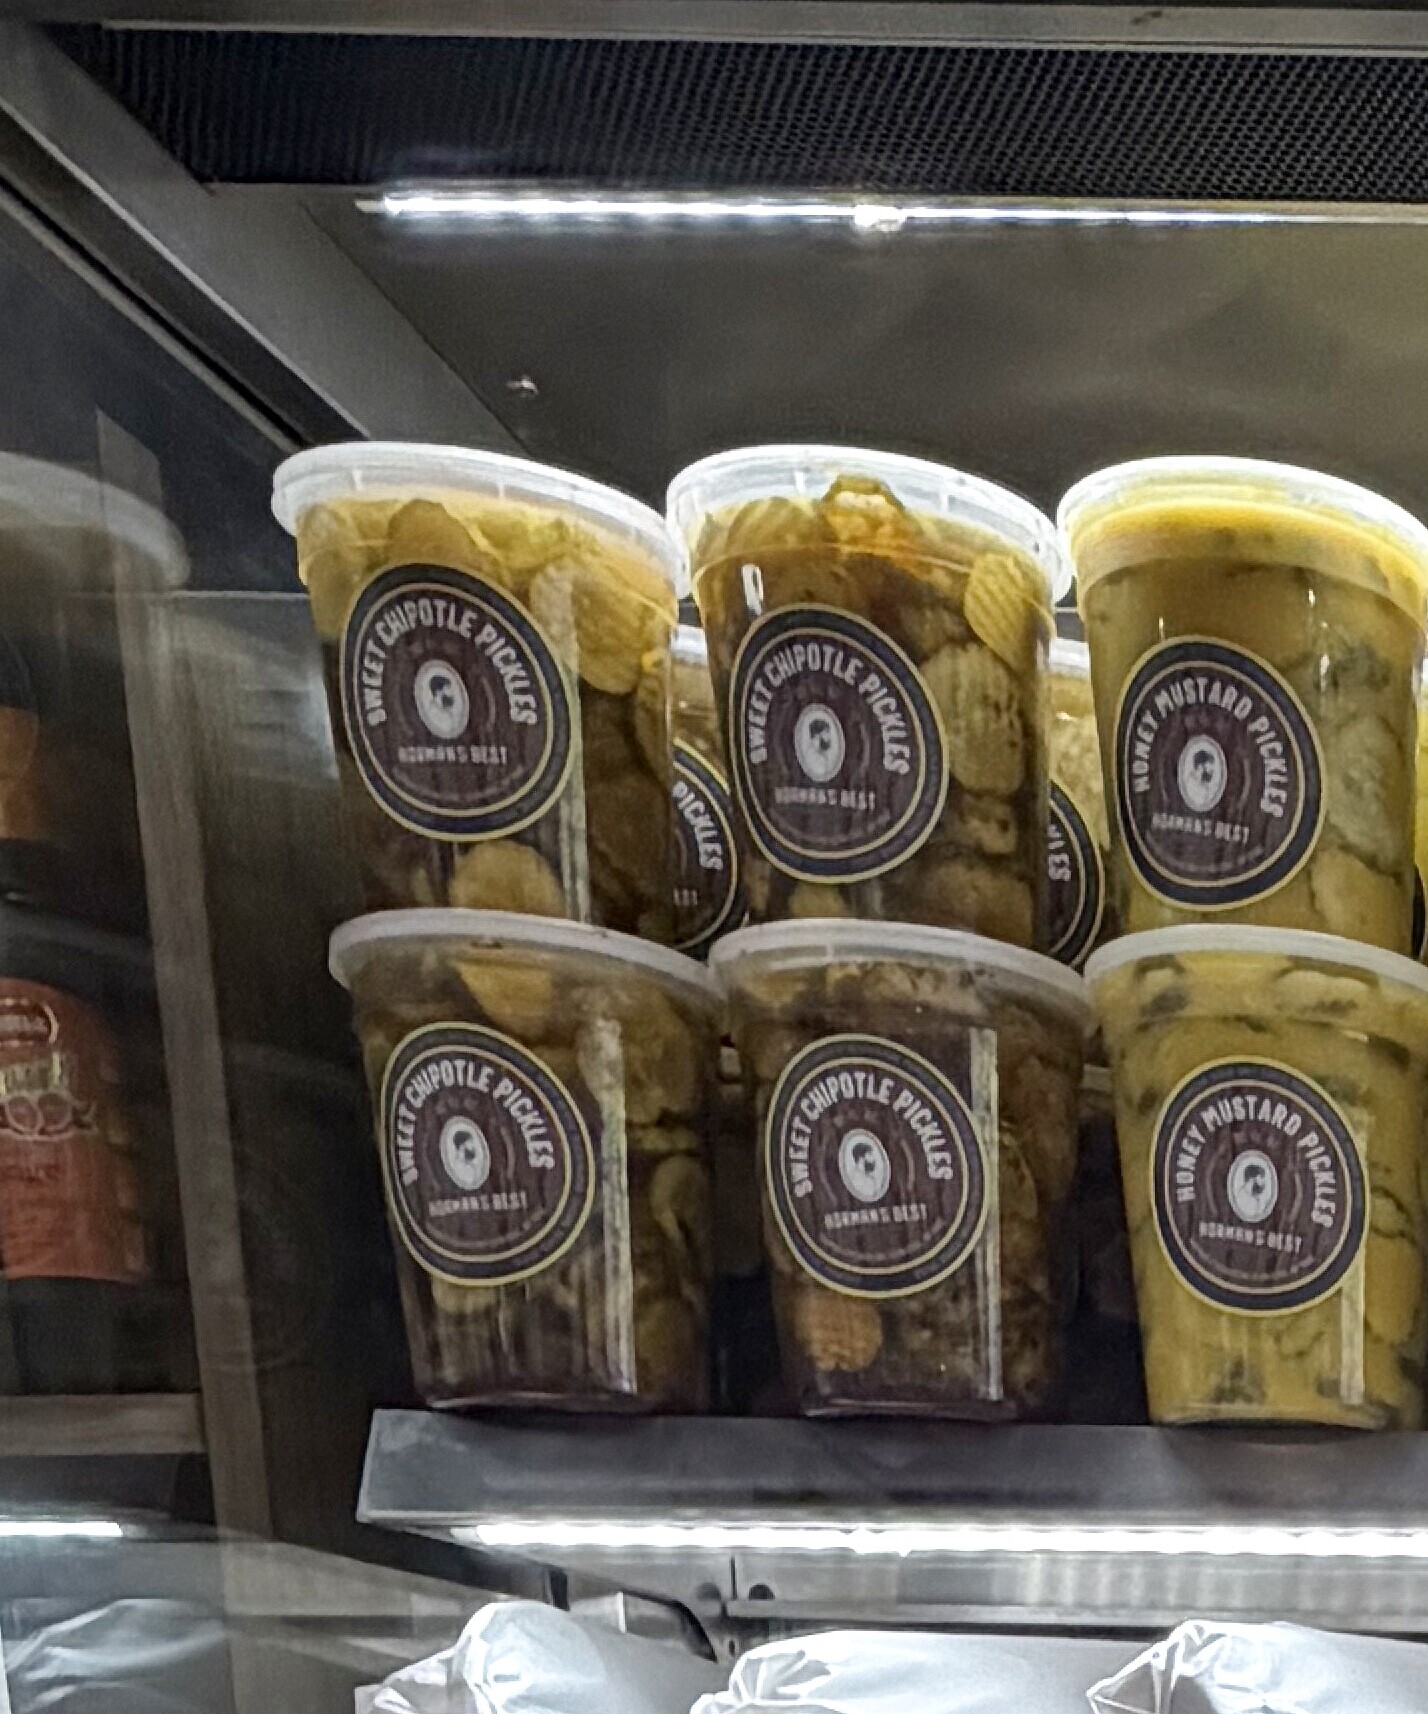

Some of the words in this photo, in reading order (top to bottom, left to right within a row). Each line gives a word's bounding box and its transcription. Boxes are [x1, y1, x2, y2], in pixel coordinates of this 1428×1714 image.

[362, 643, 388, 726] SWEET
[375, 597, 477, 645] CHIPOTLE
[475, 623, 538, 726] PICKLES
[749, 680, 772, 765] SWEET
[766, 642, 863, 688] CHIPOTLE
[858, 673, 911, 776] PICKLES
[1132, 710, 1159, 793] HONEY
[1155, 676, 1252, 720] MUSTARD
[1246, 716, 1289, 818] PICKLES
[404, 1059, 495, 1108] CHIPOTLE
[493, 1077, 555, 1169] PICKLES
[800, 1071, 894, 1121] CHIPOTLE
[396, 1104, 418, 1186] SWEET
[789, 1117, 813, 1198] SWEET
[893, 1089, 953, 1180] PICKLES
[1175, 1124, 1206, 1202] HONEY
[1200, 1095, 1301, 1135] MUSTARD
[1297, 1132, 1336, 1228] PICKLES
